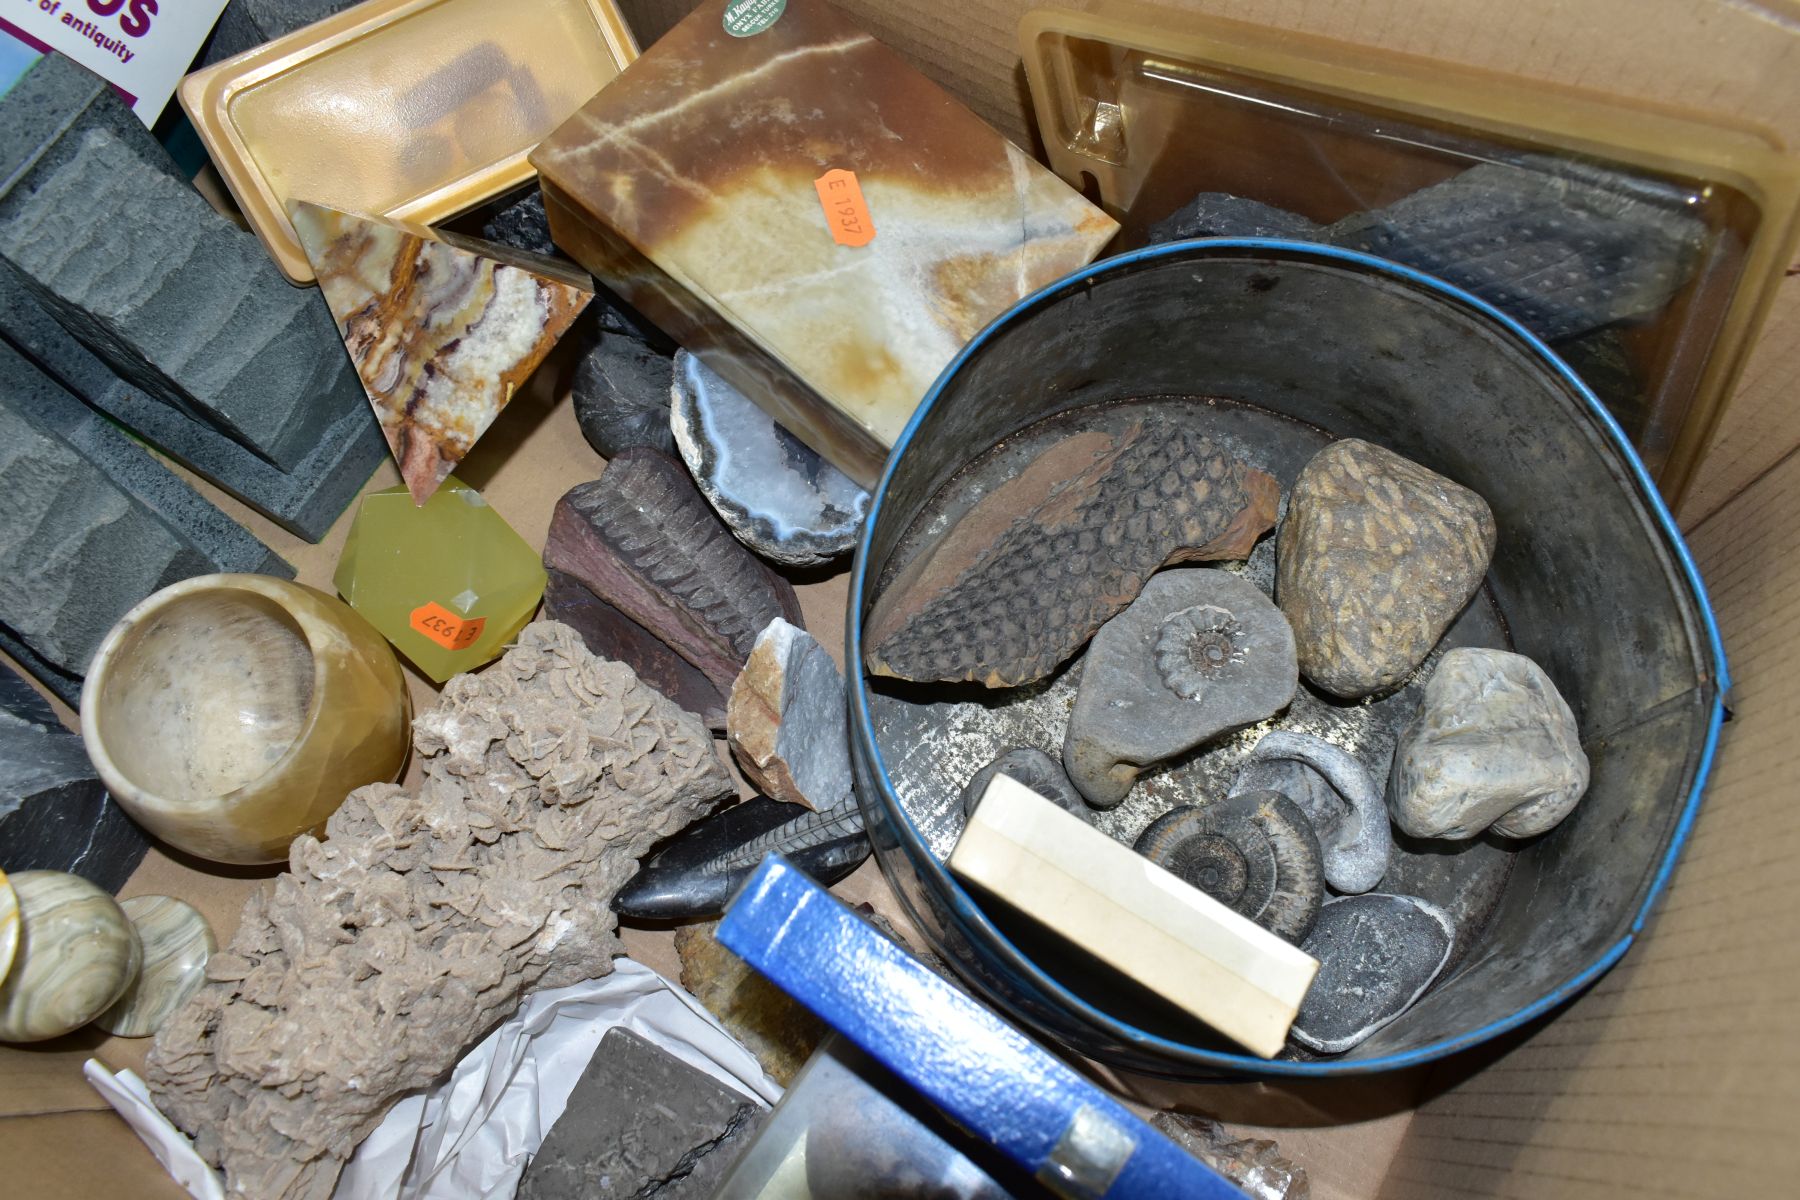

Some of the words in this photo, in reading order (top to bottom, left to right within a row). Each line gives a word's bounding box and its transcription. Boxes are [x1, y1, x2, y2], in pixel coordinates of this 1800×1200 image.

[39, 0, 62, 15] of
[61, 11, 135, 64] antiquity
[732, 12, 753, 31] ONYX
[834, 198, 863, 234] 1937
[422, 615, 464, 642] 1937
